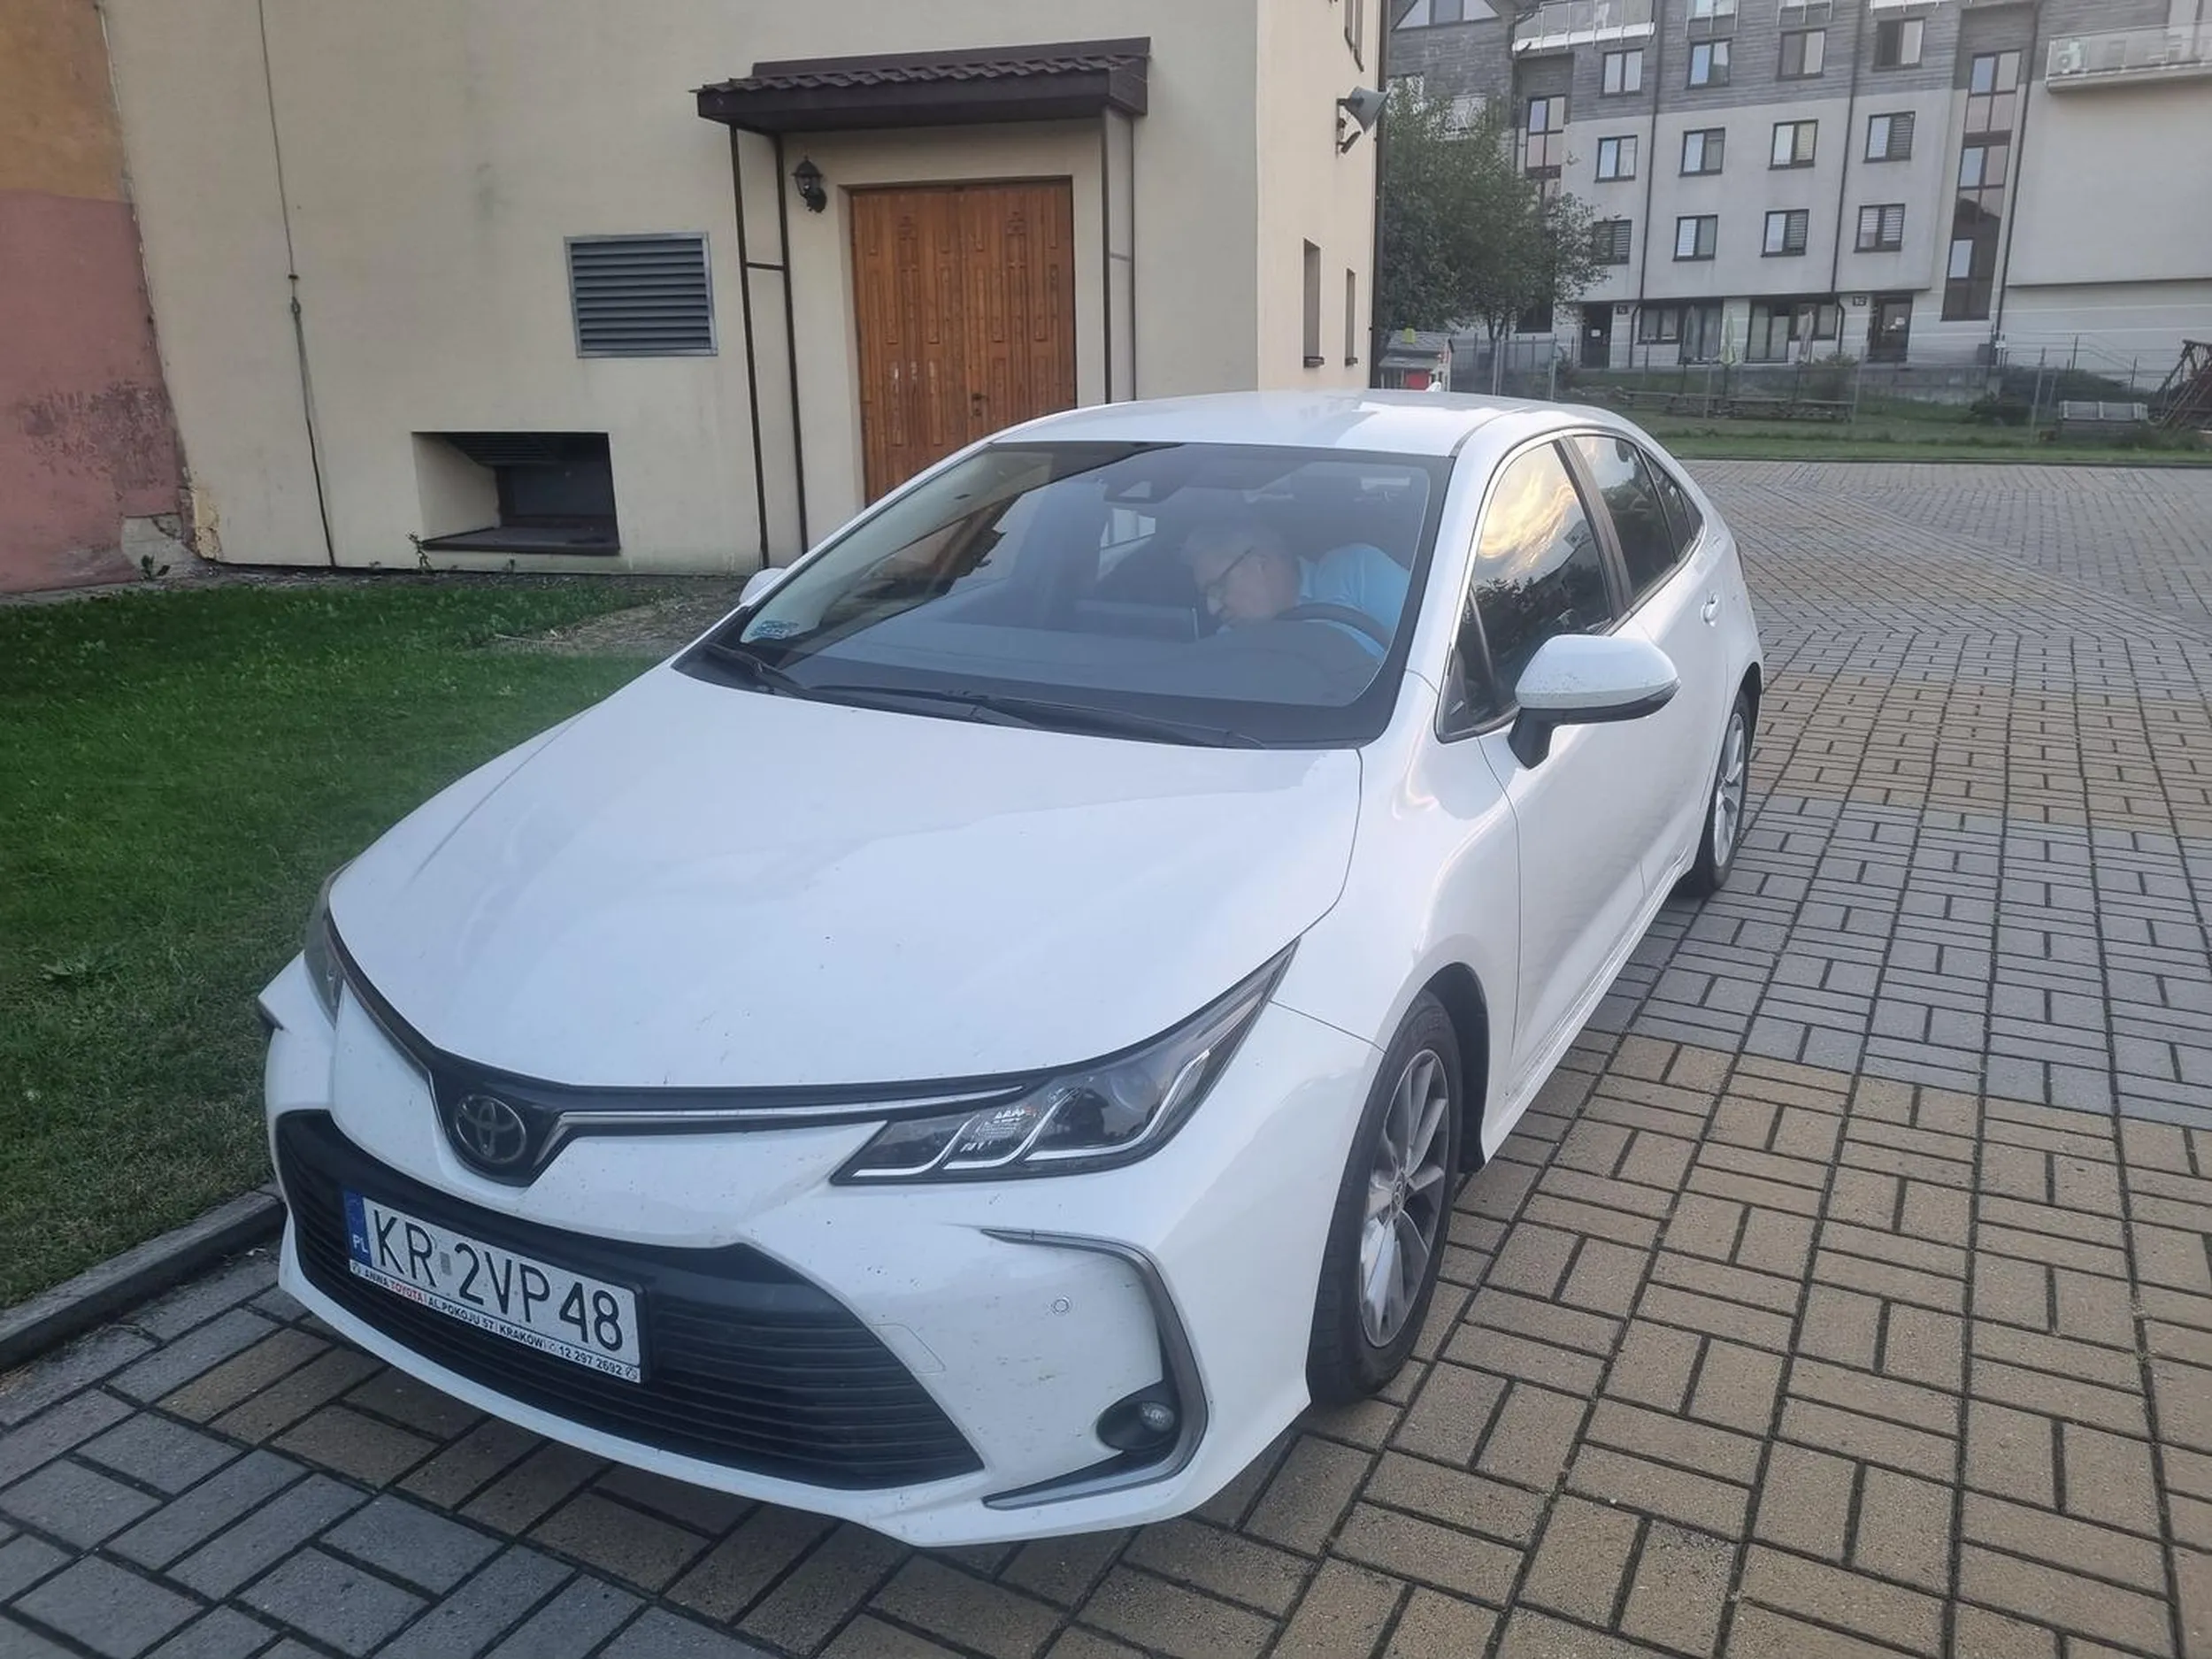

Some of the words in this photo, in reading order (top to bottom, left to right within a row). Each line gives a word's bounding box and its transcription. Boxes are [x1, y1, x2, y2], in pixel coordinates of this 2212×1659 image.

[352, 1233, 369, 1254] PL
[373, 1209, 437, 1287] KR
[454, 1242, 623, 1352] 2VP48
[389, 1279, 423, 1303] TOYOTA
[559, 1346, 572, 1359] 12
[574, 1350, 593, 1364] 297
[595, 1356, 622, 1375] 2692
